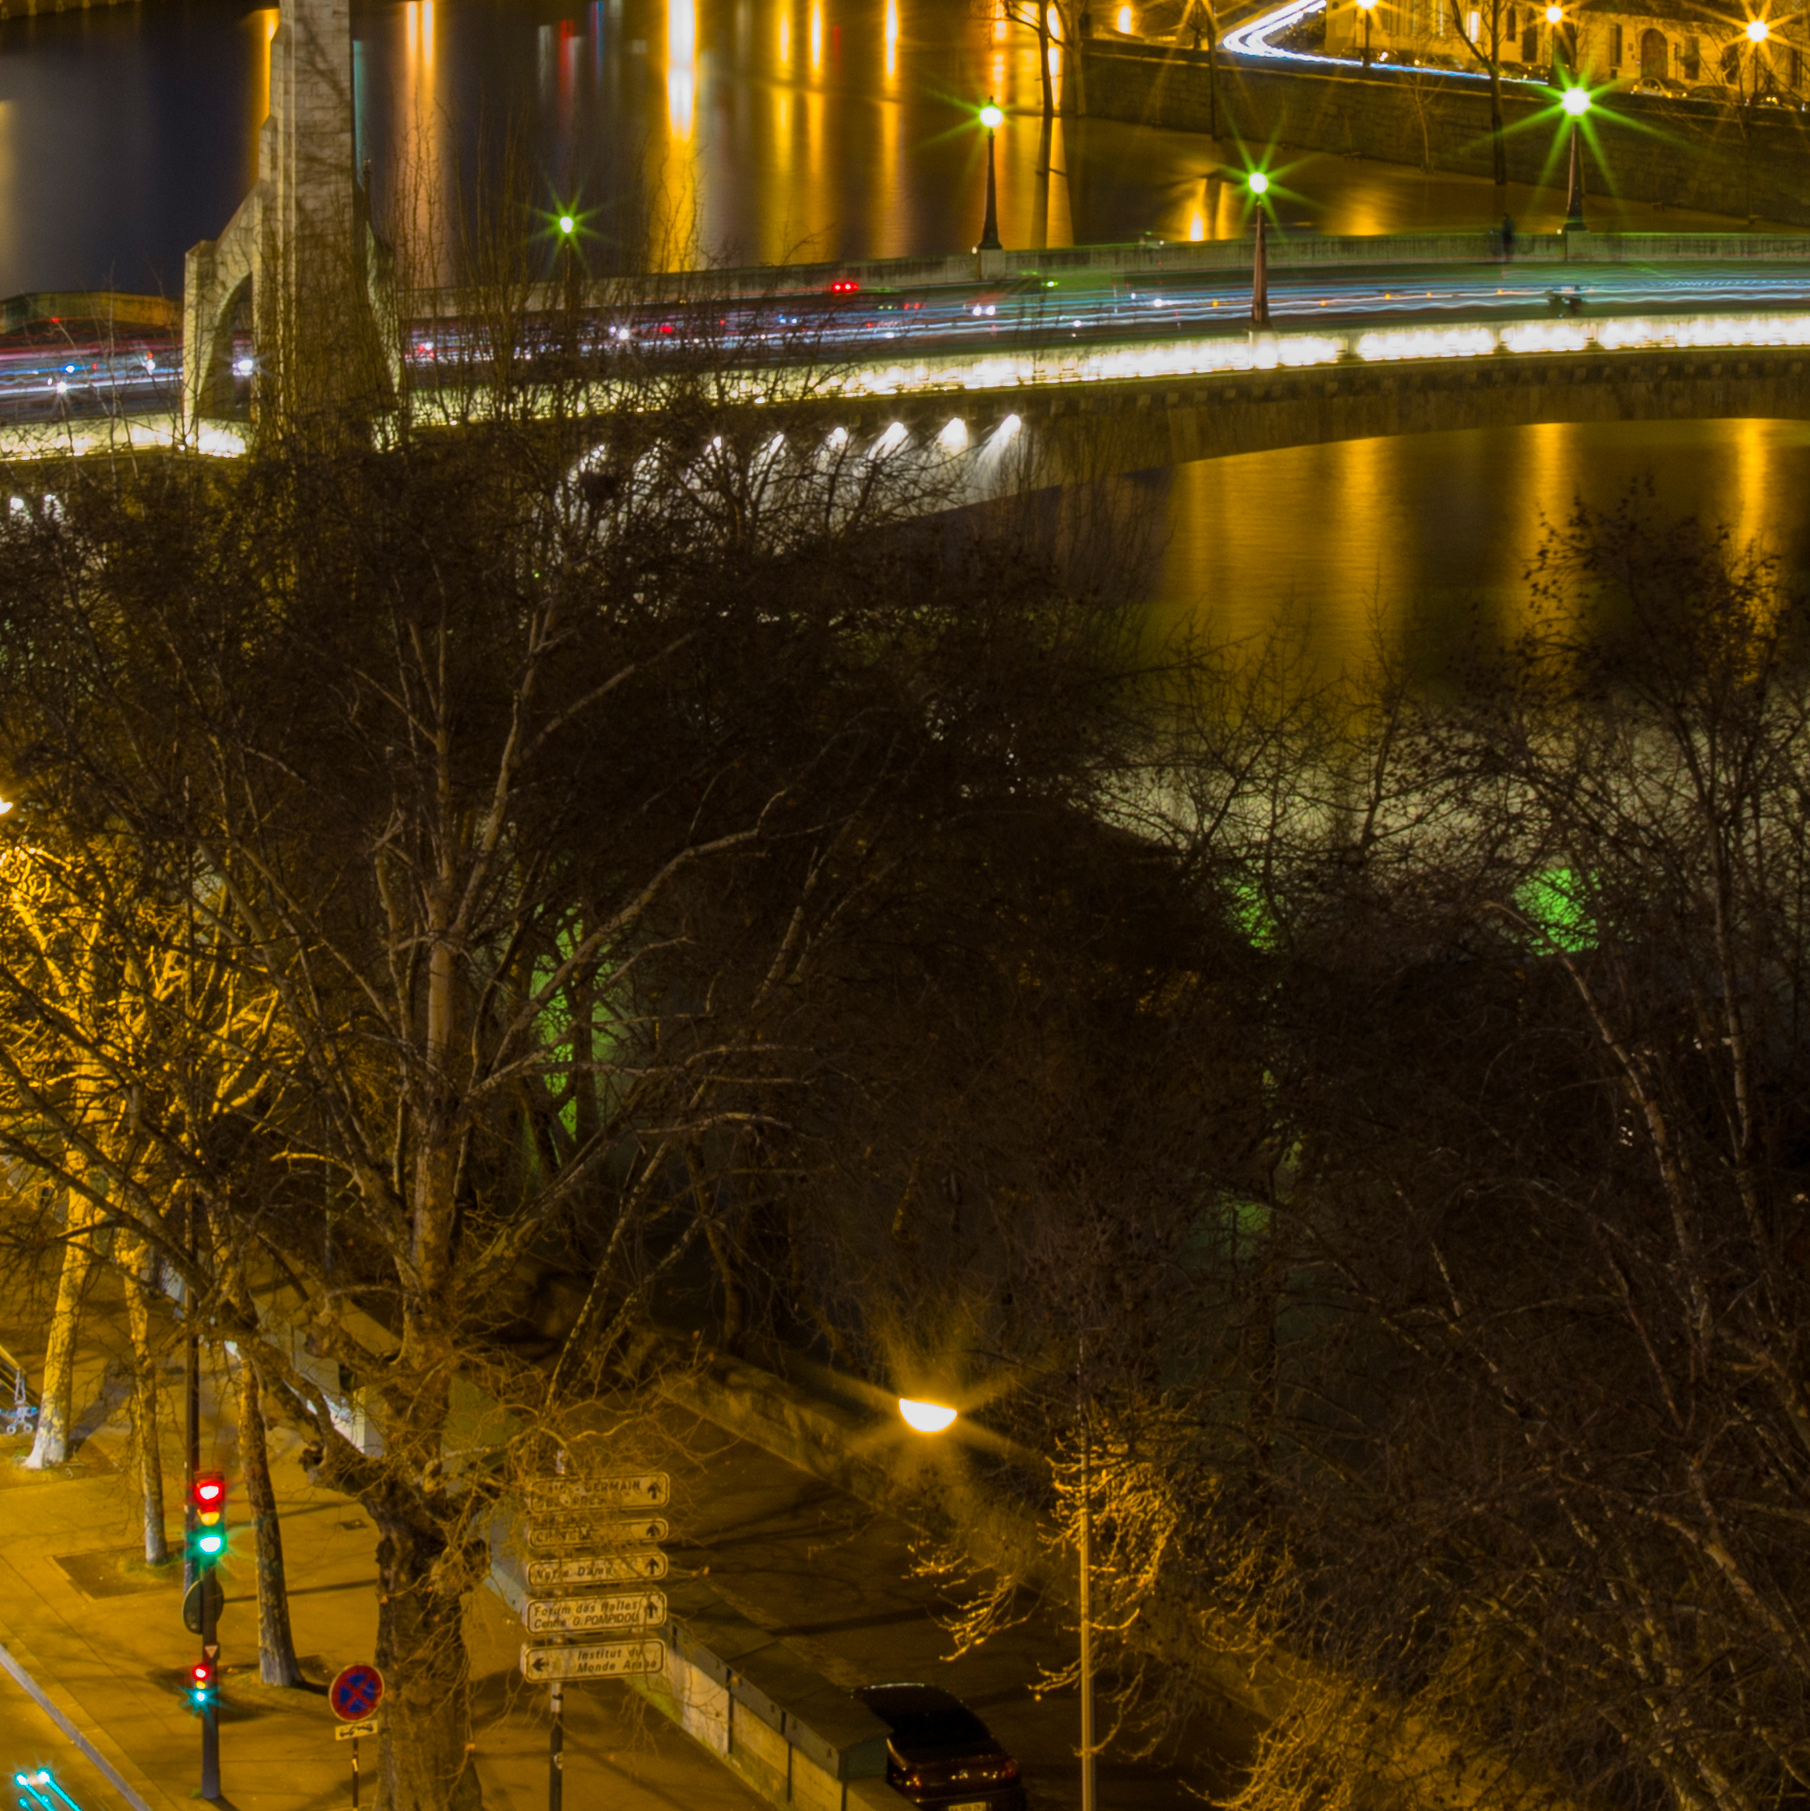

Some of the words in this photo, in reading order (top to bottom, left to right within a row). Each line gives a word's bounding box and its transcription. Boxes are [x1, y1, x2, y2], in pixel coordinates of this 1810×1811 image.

[534, 1605, 571, 1617] Forum
[576, 1602, 595, 1614] des
[600, 1598, 637, 1613] Halles
[577, 1649, 621, 1661] Institut
[628, 1647, 642, 1658] du
[577, 1662, 616, 1674] Monde
